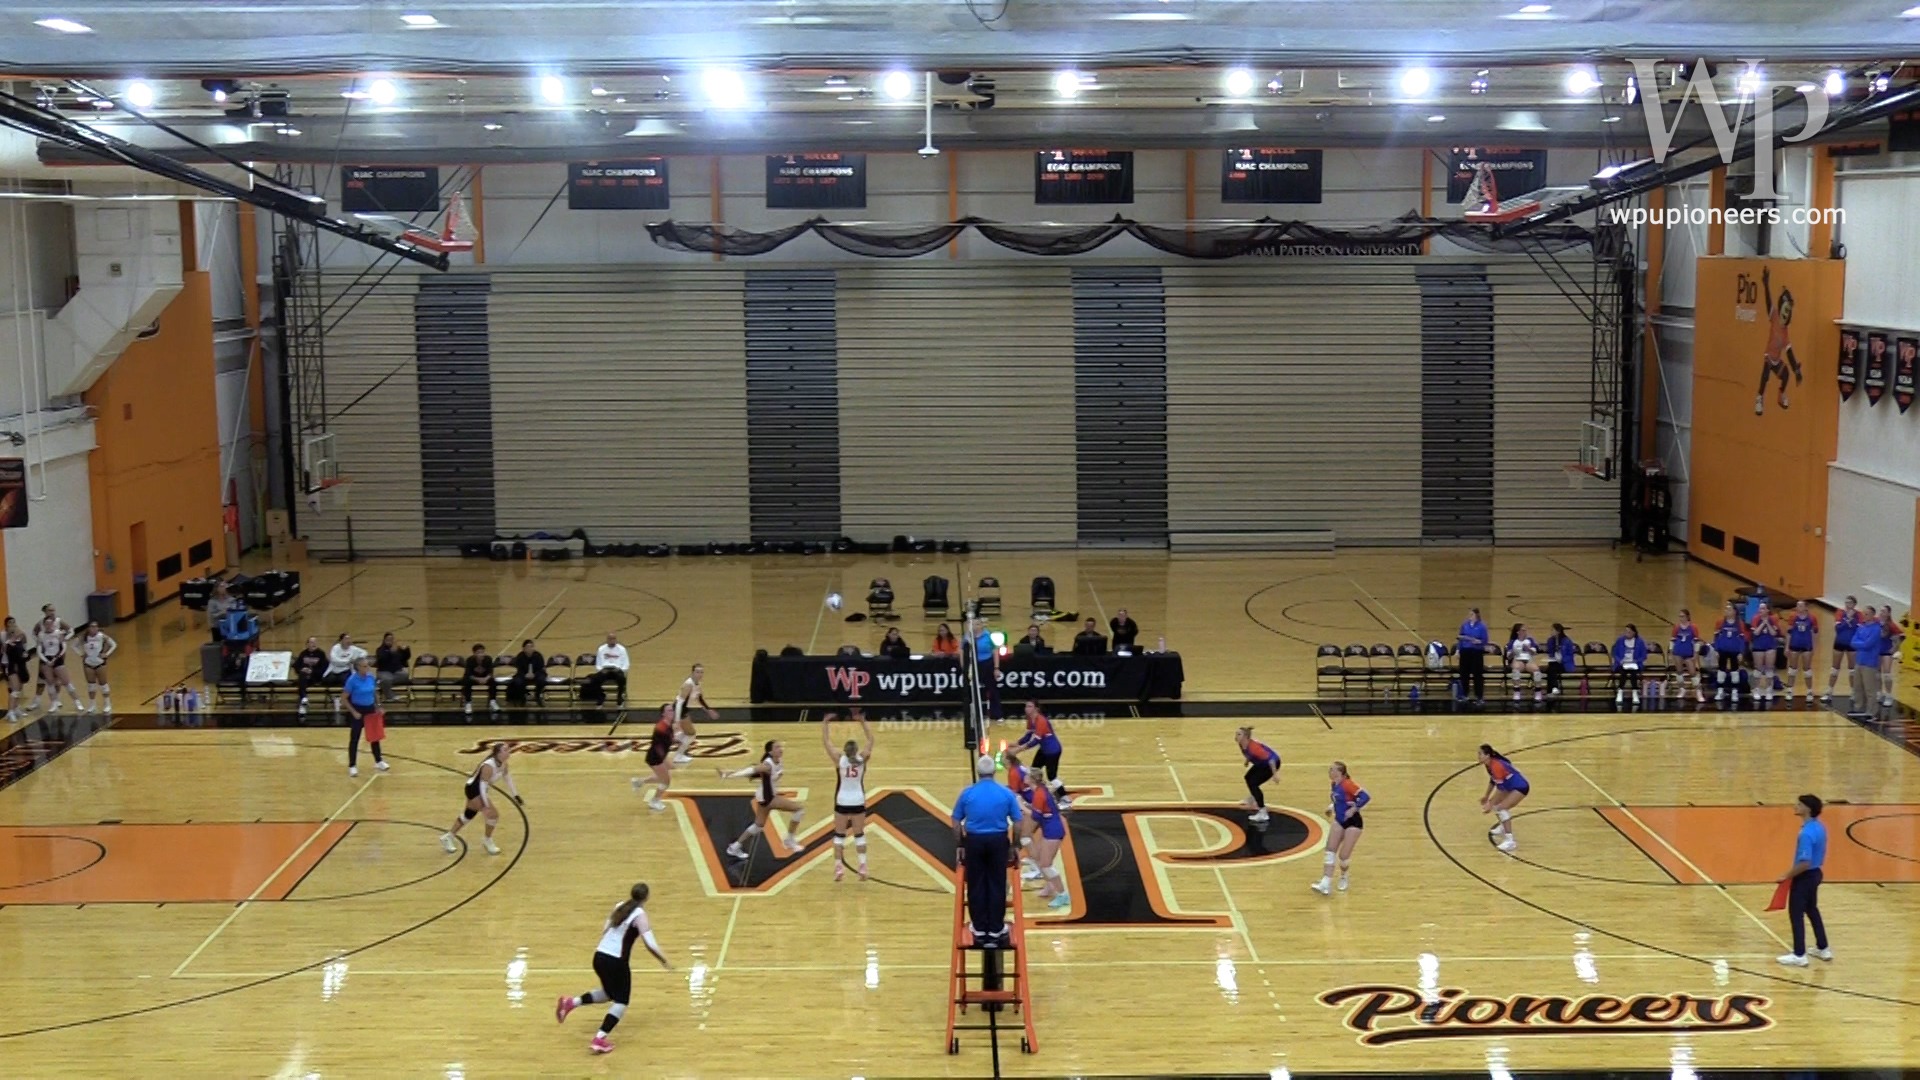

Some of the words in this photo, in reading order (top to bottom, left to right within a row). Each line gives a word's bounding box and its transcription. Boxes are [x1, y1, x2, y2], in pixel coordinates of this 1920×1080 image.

[802, 166, 854, 176] CHAMPIONS
[1071, 162, 1122, 171] CHAMPIONS
[1258, 162, 1309, 170] CHAMPIONS
[375, 170, 427, 178] CHAMPIONS
[604, 168, 656, 176] CHAMPIONS
[1279, 244, 1342, 256] PATERSON
[825, 666, 870, 698] WP
[845, 765, 859, 778] 15
[1314, 984, 1778, 1047] Pioneers
